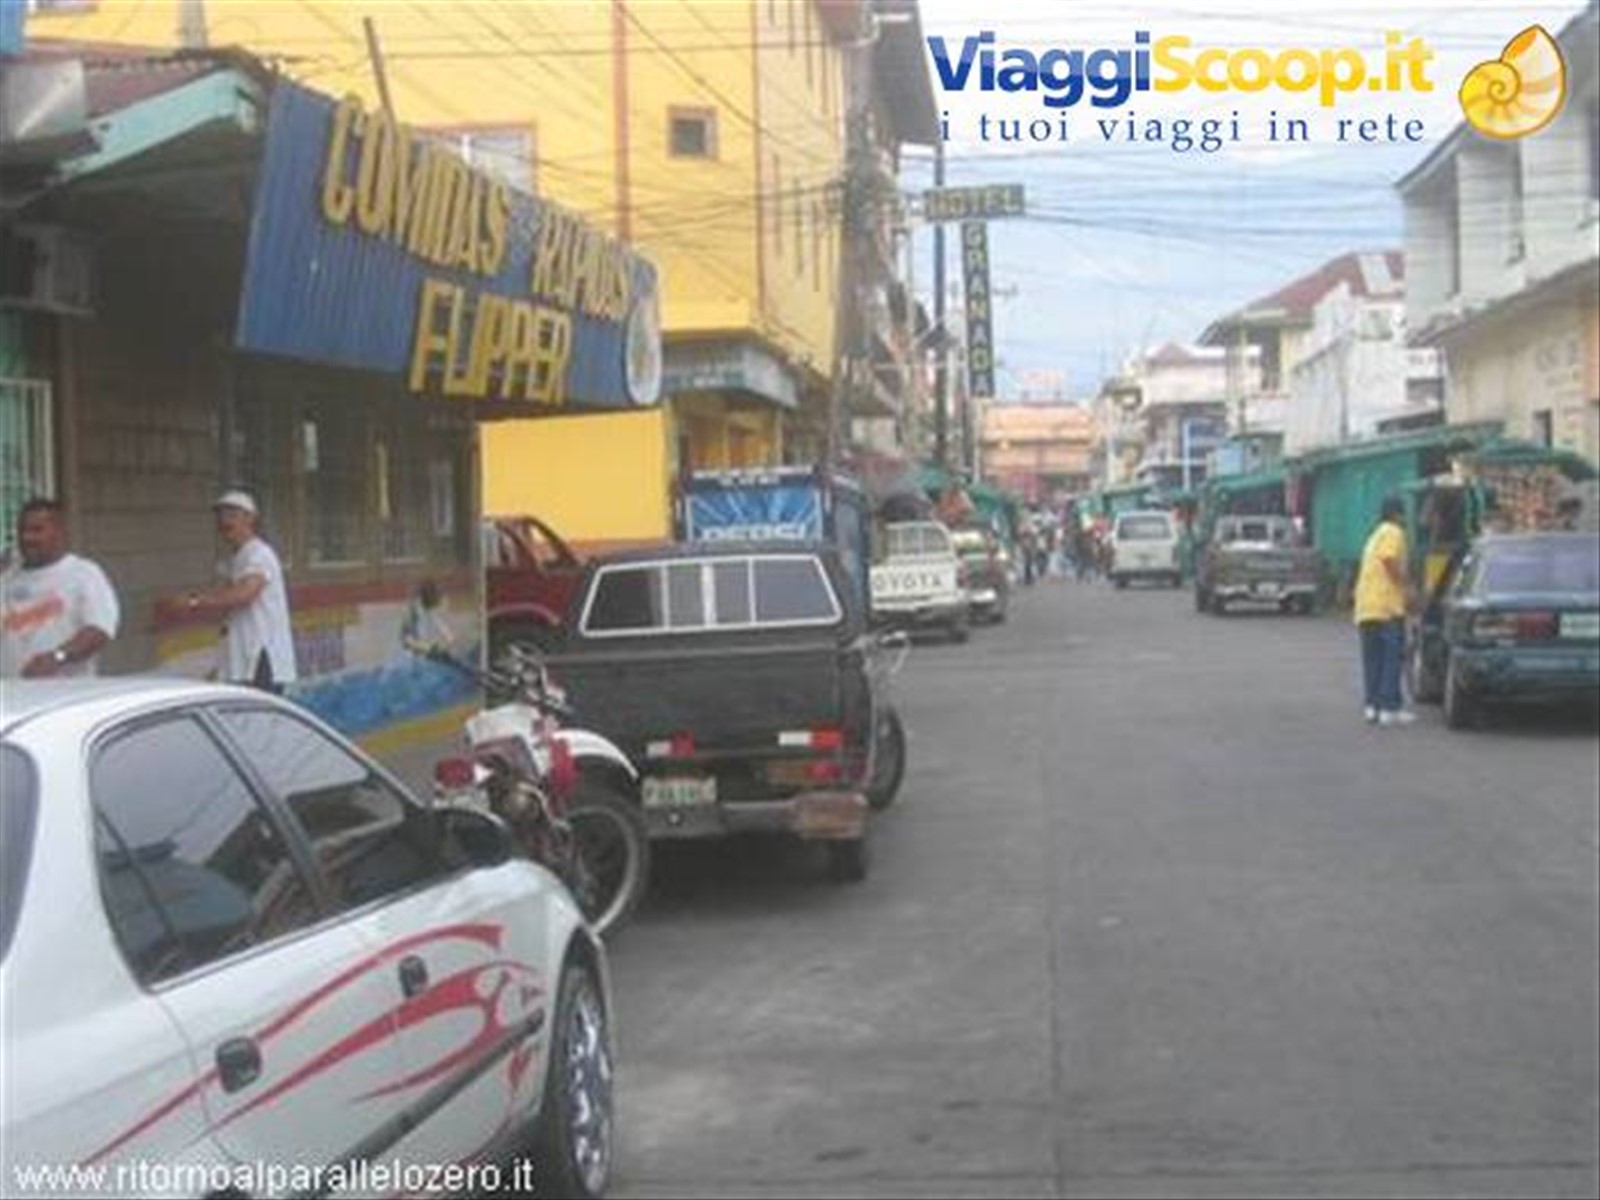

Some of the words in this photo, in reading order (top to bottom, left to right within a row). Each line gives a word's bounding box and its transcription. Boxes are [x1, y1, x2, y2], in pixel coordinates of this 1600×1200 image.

[324, 92, 509, 275] COMIDAS
[926, 187, 1021, 218] HOTEL
[410, 281, 571, 405] FLIPPER
[963, 223, 992, 396] GRANADA
[871, 572, 944, 592] OYOTA
